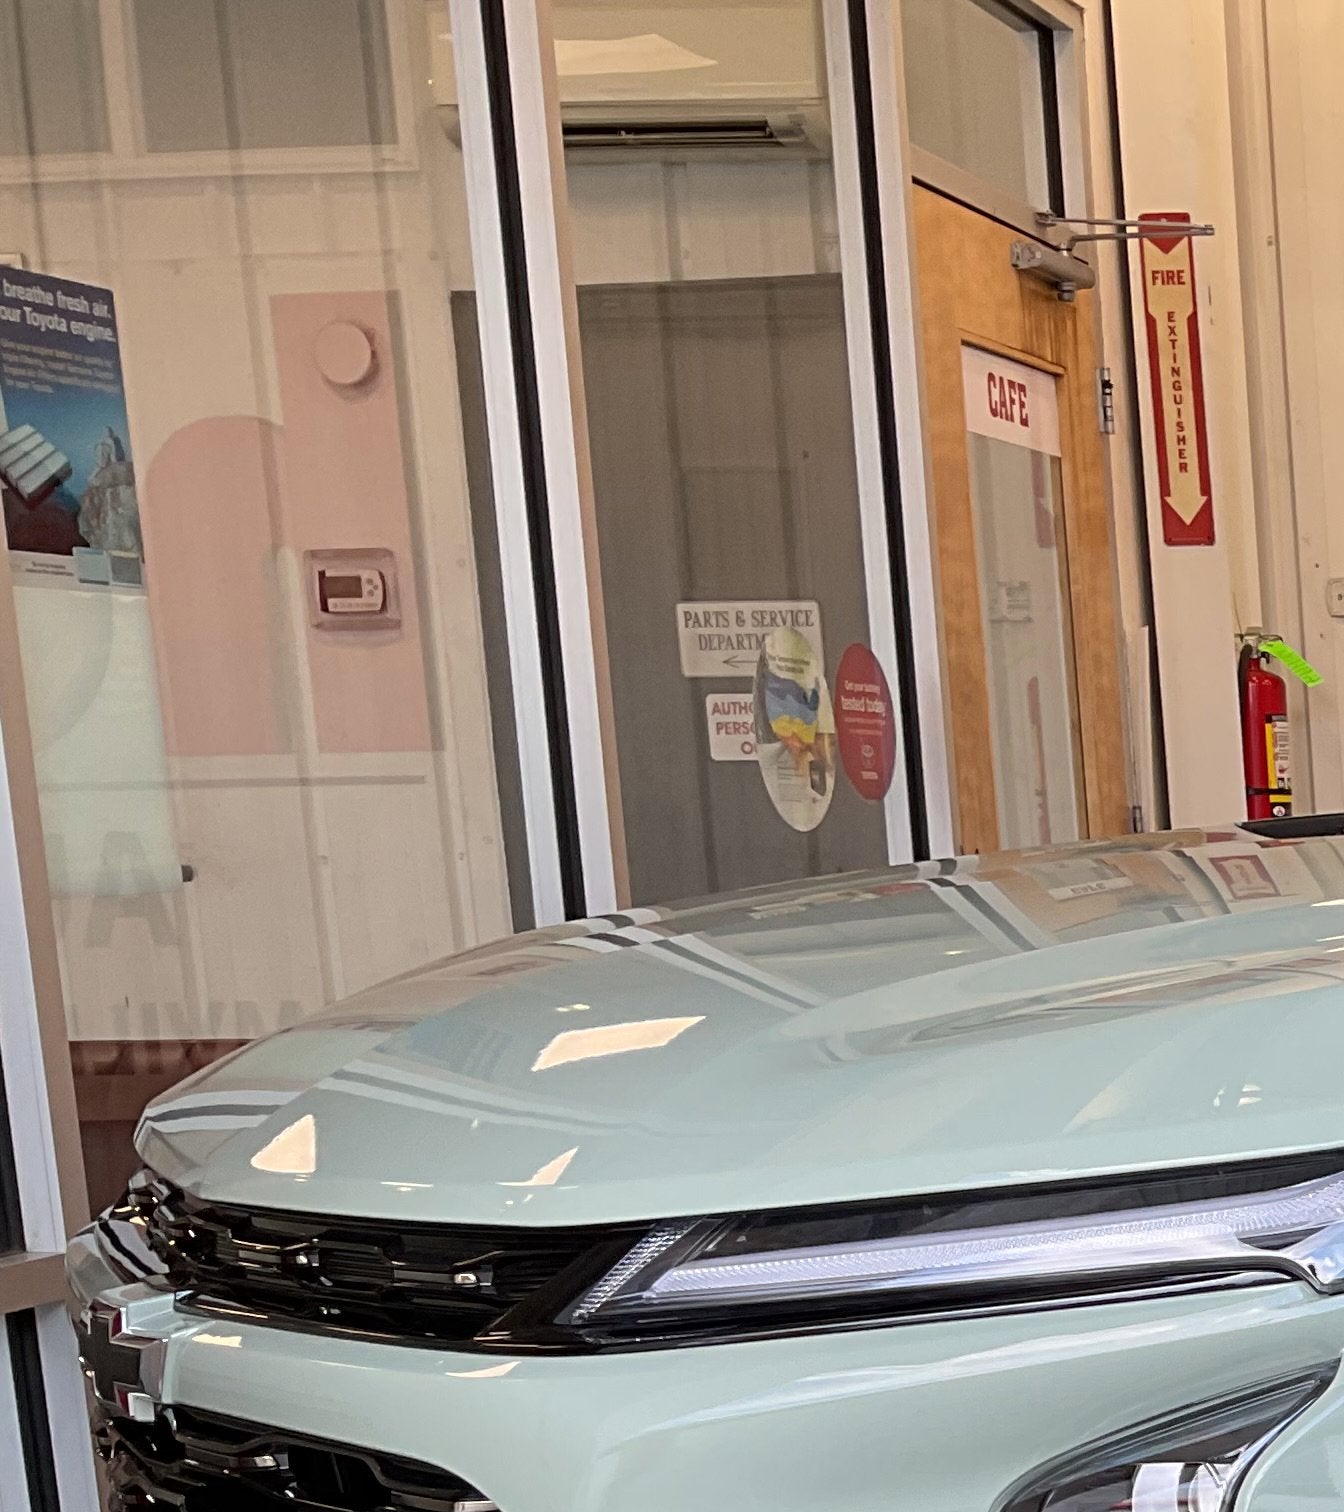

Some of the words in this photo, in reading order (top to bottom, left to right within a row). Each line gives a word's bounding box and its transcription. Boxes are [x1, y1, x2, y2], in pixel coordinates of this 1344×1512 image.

[1151, 269, 1186, 286] FIRE
[2, 278, 54, 306] breathe
[56, 290, 90, 314] fresh
[23, 306, 68, 332] Toyota
[987, 371, 1030, 428] CAFE
[1167, 311, 1189, 474] EXTINGUISHER
[683, 610, 730, 628] PARTS
[735, 610, 746, 628] &
[751, 609, 815, 628] SERVICE
[698, 632, 769, 651] DEPARTM
